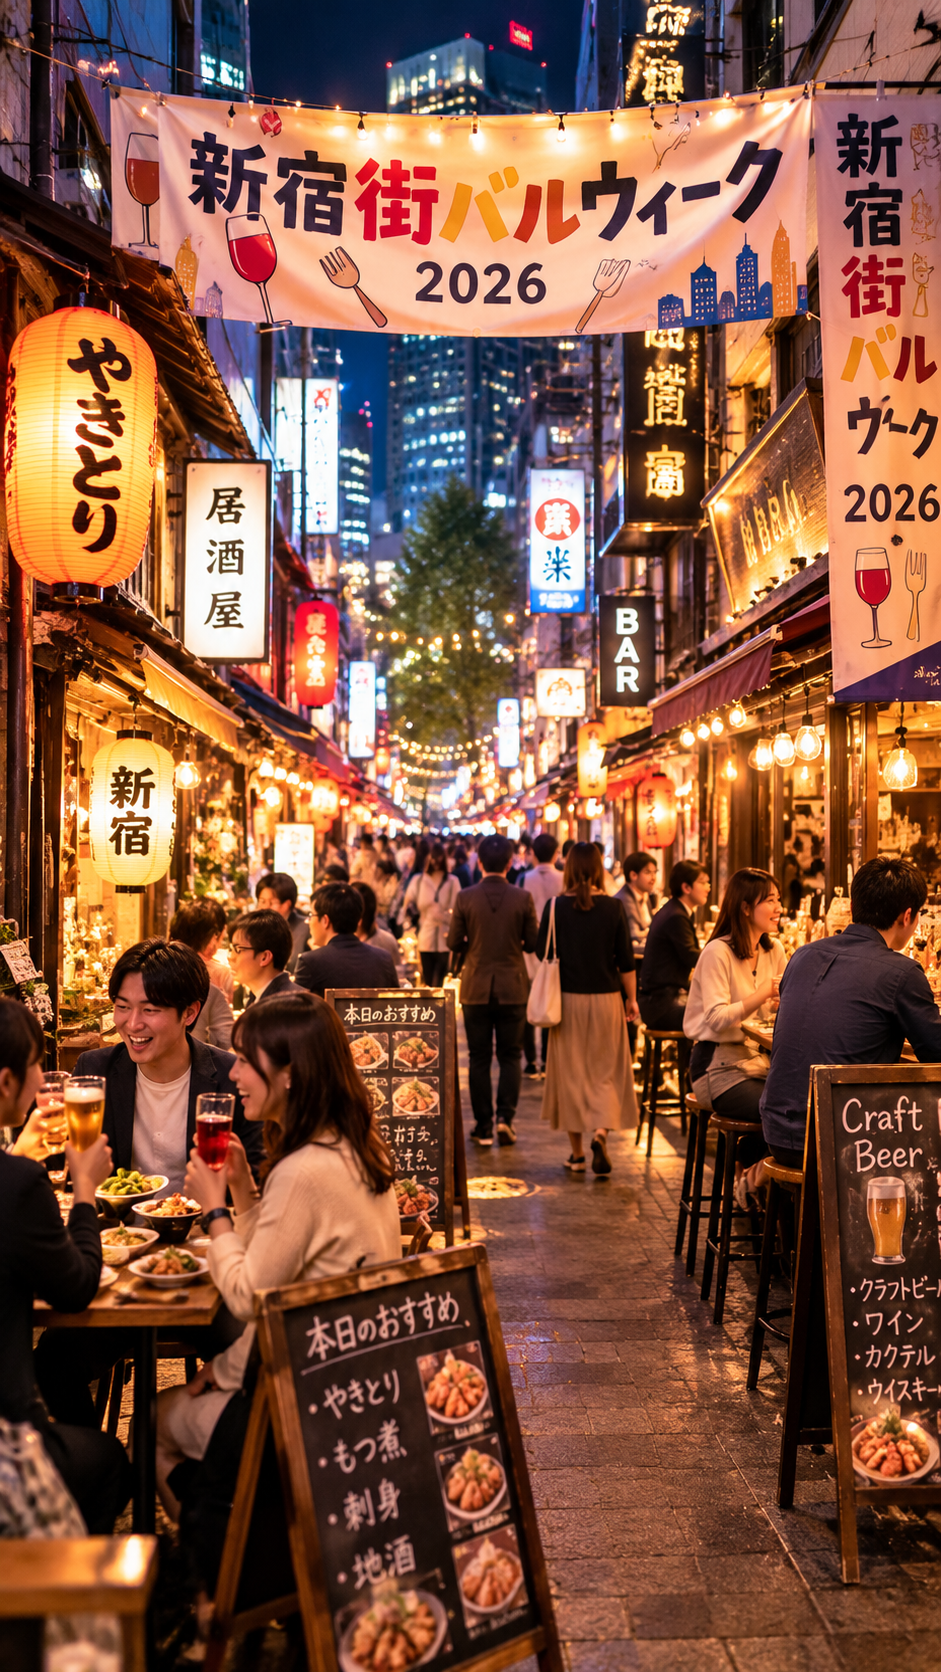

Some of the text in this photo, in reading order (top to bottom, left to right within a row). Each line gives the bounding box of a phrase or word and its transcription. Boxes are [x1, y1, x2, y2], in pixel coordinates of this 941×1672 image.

[188, 131, 783, 245] 新宿街バルウィーク
[415, 261, 547, 304] 2026
[67, 337, 132, 553] やきとり
[844, 484, 941, 522] 2026
[204, 486, 246, 629] 居酒屋
[614, 607, 640, 692] BAR
[109, 766, 155, 856] 新宿
[343, 1003, 436, 1025] 本日のおすすめ
[842, 1096, 923, 1133] Craft
[854, 1139, 923, 1172] Beer
[305, 1291, 459, 1360] 本日のおすすめ
[865, 1310, 923, 1336] ワイン
[865, 1343, 936, 1369] カクテル
[323, 1369, 400, 1419] やきとり
[868, 1376, 941, 1405] ウイスキー
[333, 1418, 407, 1474] もつ煮
[343, 1478, 400, 1532] 刺身
[351, 1534, 416, 1590] 地酒
